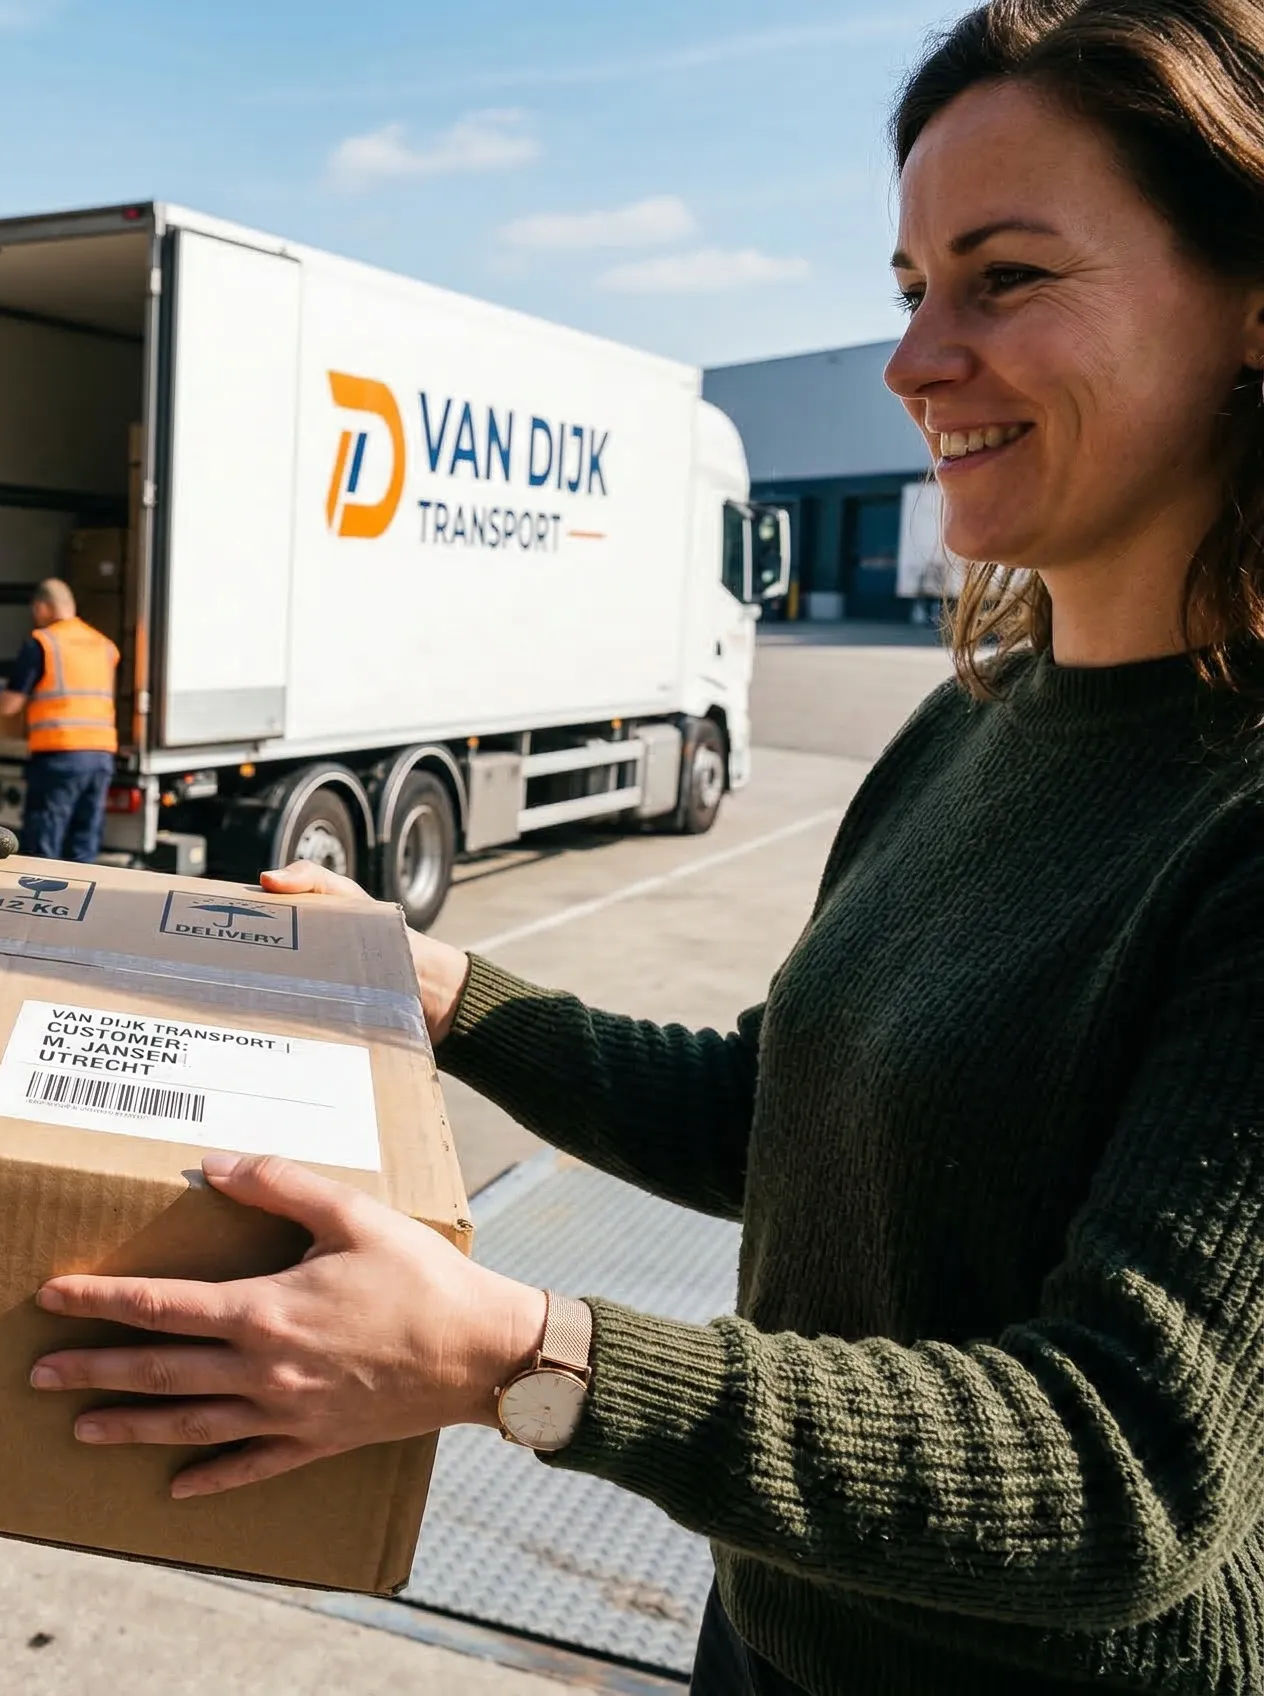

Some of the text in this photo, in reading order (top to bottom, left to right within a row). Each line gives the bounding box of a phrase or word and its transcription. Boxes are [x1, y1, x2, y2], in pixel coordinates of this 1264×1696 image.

[419, 391, 609, 496] VAN DIJK
[418, 500, 561, 552] TRANSPORT
[31, 902, 70, 917] KG
[175, 923, 285, 945] DELIVERY
[47, 1021, 189, 1051] CUSTOMER:
[52, 1009, 92, 1023] VAN
[100, 1016, 146, 1031] DIJK
[153, 1024, 277, 1049] TRANSPORT
[39, 1049, 155, 1075] UTRECHT
[42, 1035, 178, 1064] M. JANSEN
